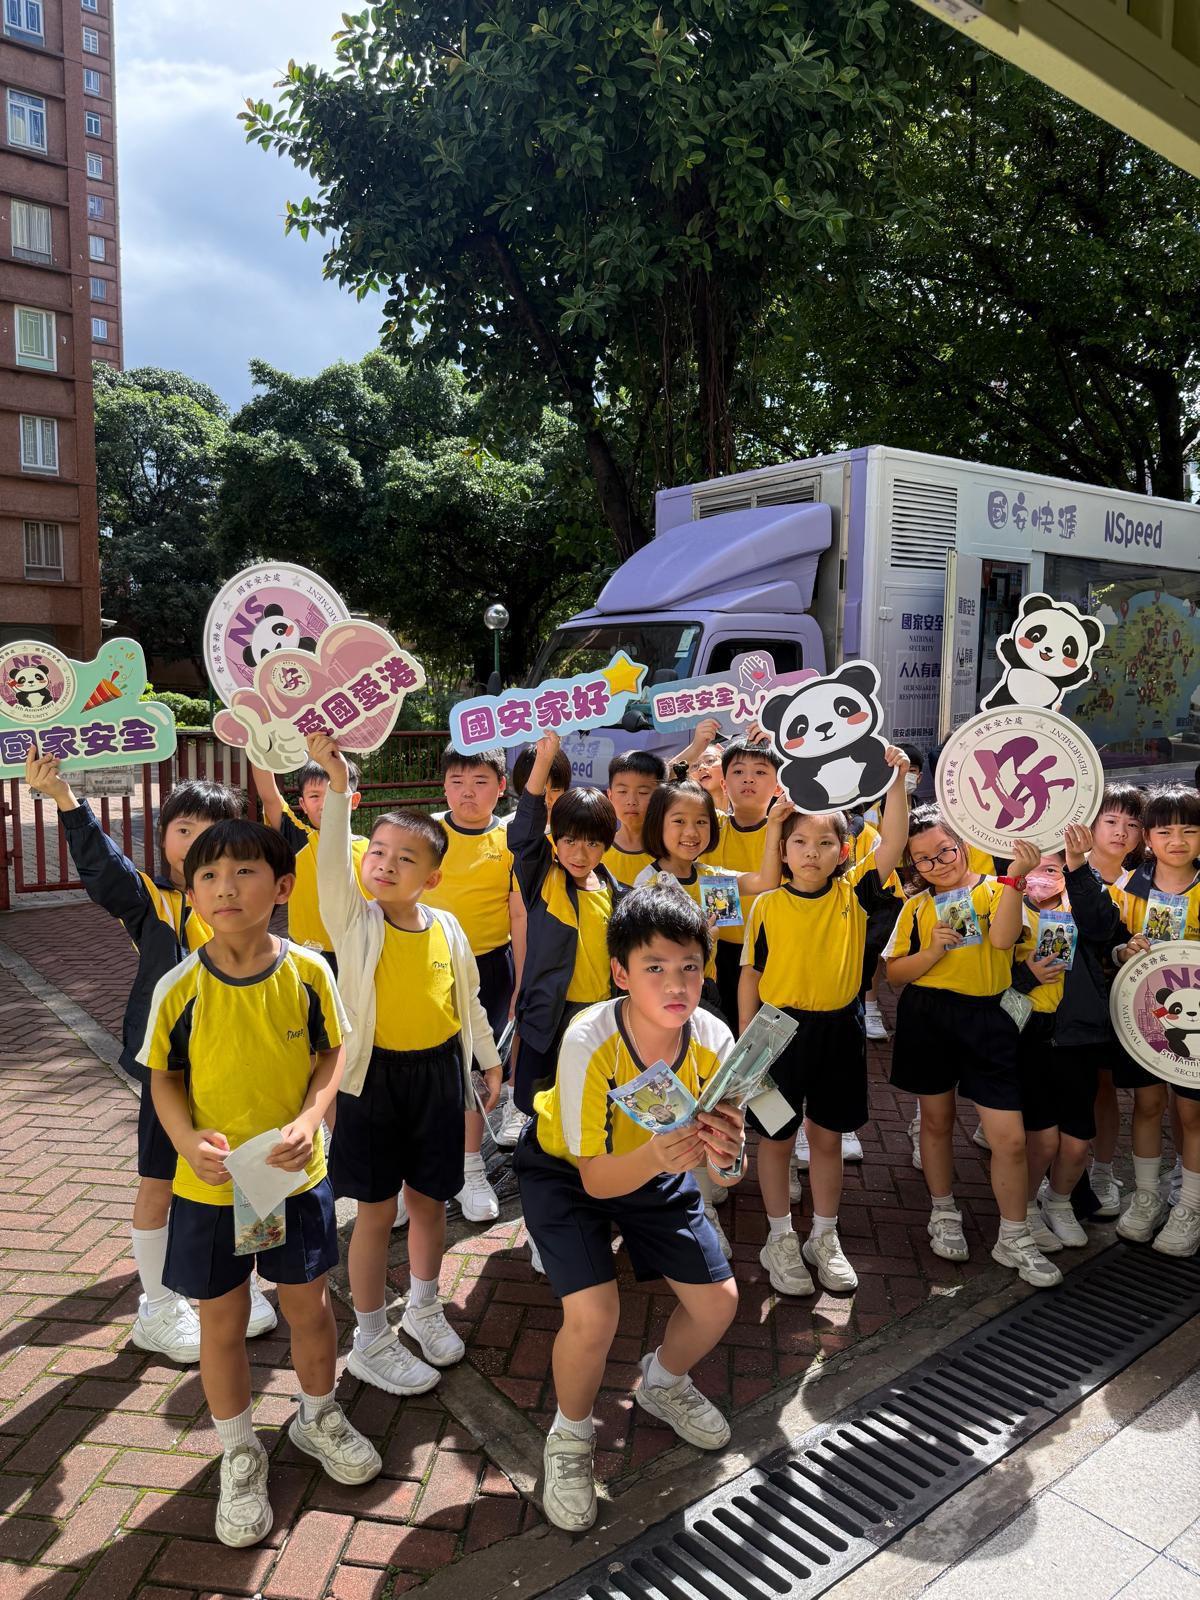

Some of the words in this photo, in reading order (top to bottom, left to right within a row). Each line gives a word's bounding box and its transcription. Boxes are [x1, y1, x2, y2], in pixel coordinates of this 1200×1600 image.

[987, 490, 1077, 539] 國安快遞
[1104, 510, 1162, 549] NSpeed
[228, 595, 266, 647] NS
[306, 586, 338, 624] ARTMENT
[902, 613, 943, 631] 國家安全
[12, 655, 43, 669] NS
[293, 657, 417, 737] 愛國愛港
[460, 681, 610, 745] 國安家好
[657, 687, 735, 717] 國家安全
[0, 718, 156, 765] 國家安全
[1050, 728, 1088, 775] DEPARTMENT
[572, 760, 593, 778] eed
[969, 824, 1013, 847] NATIONAL
[1129, 953, 1168, 983] 香港警務處
[1121, 1004, 1142, 1047] NATIONAL
[1161, 1049, 1178, 1063] 5th
[1178, 1057, 1200, 1067] Anni
[1174, 1066, 1200, 1079] SECU
